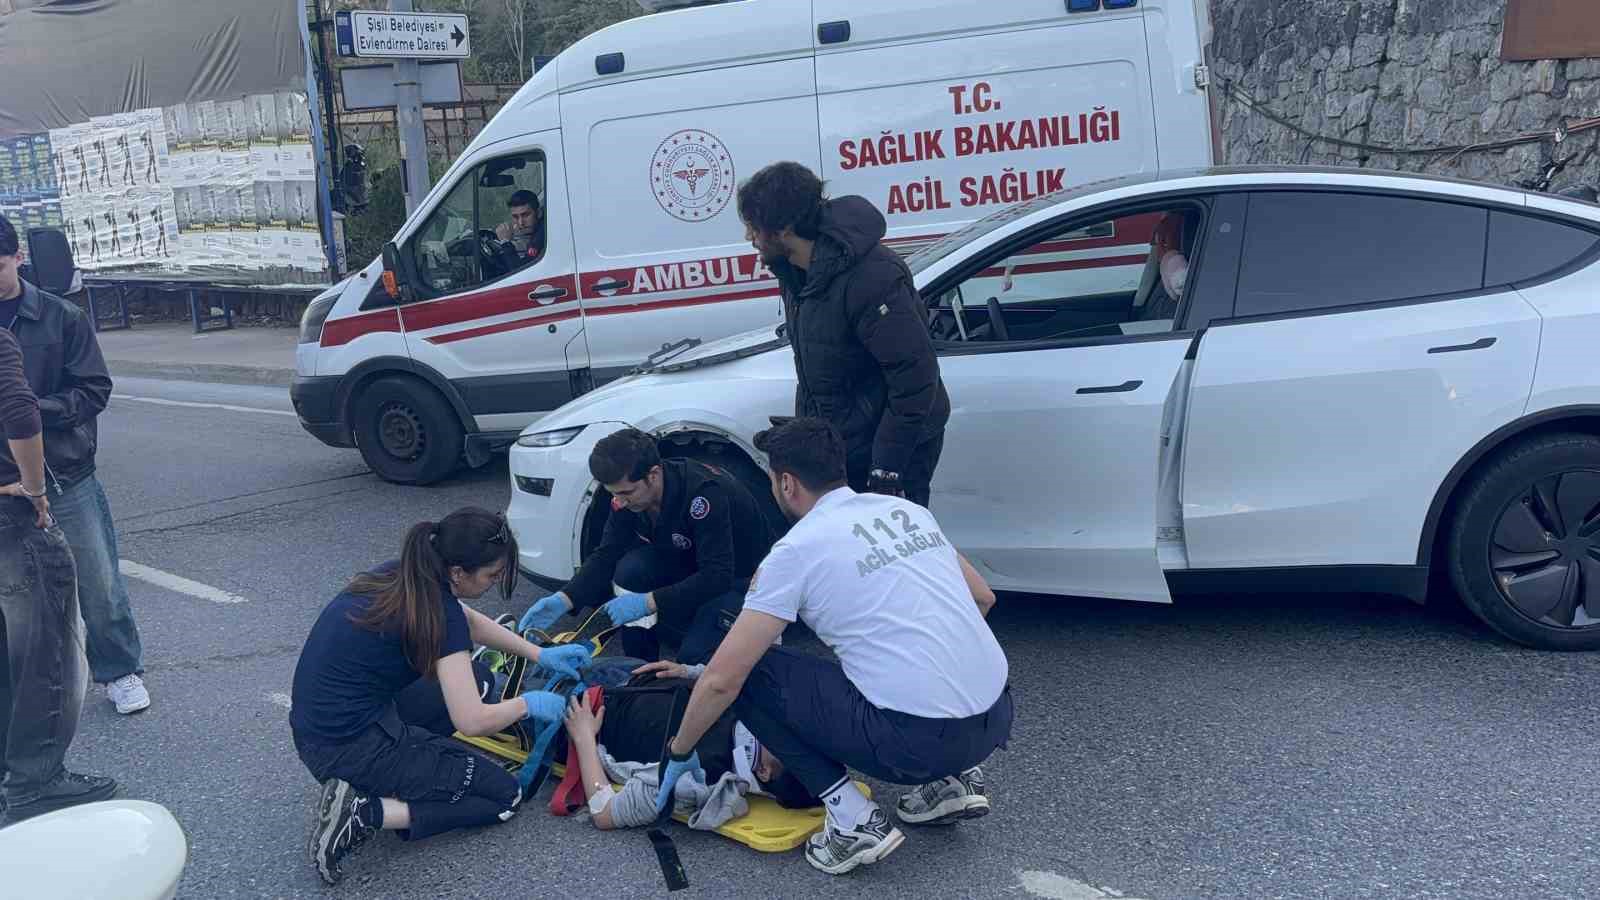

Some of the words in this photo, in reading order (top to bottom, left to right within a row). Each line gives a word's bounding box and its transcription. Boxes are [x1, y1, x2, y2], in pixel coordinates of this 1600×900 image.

[360, 36, 415, 50] Evlendirme
[417, 37, 448, 51] Dairesi
[367, 17, 388, 32] Şişli
[390, 18, 438, 36] Belediyesi
[948, 82, 1001, 115] T.C.
[839, 130, 945, 170] SAĞLIK
[954, 105, 1120, 157] BAKANLIĞI
[887, 176, 951, 214] ACİL
[959, 167, 1067, 207] SAĞLIK
[852, 509, 920, 546] 112
[856, 546, 898, 578] ACİL
[894, 532, 946, 558] SAĞLIK
